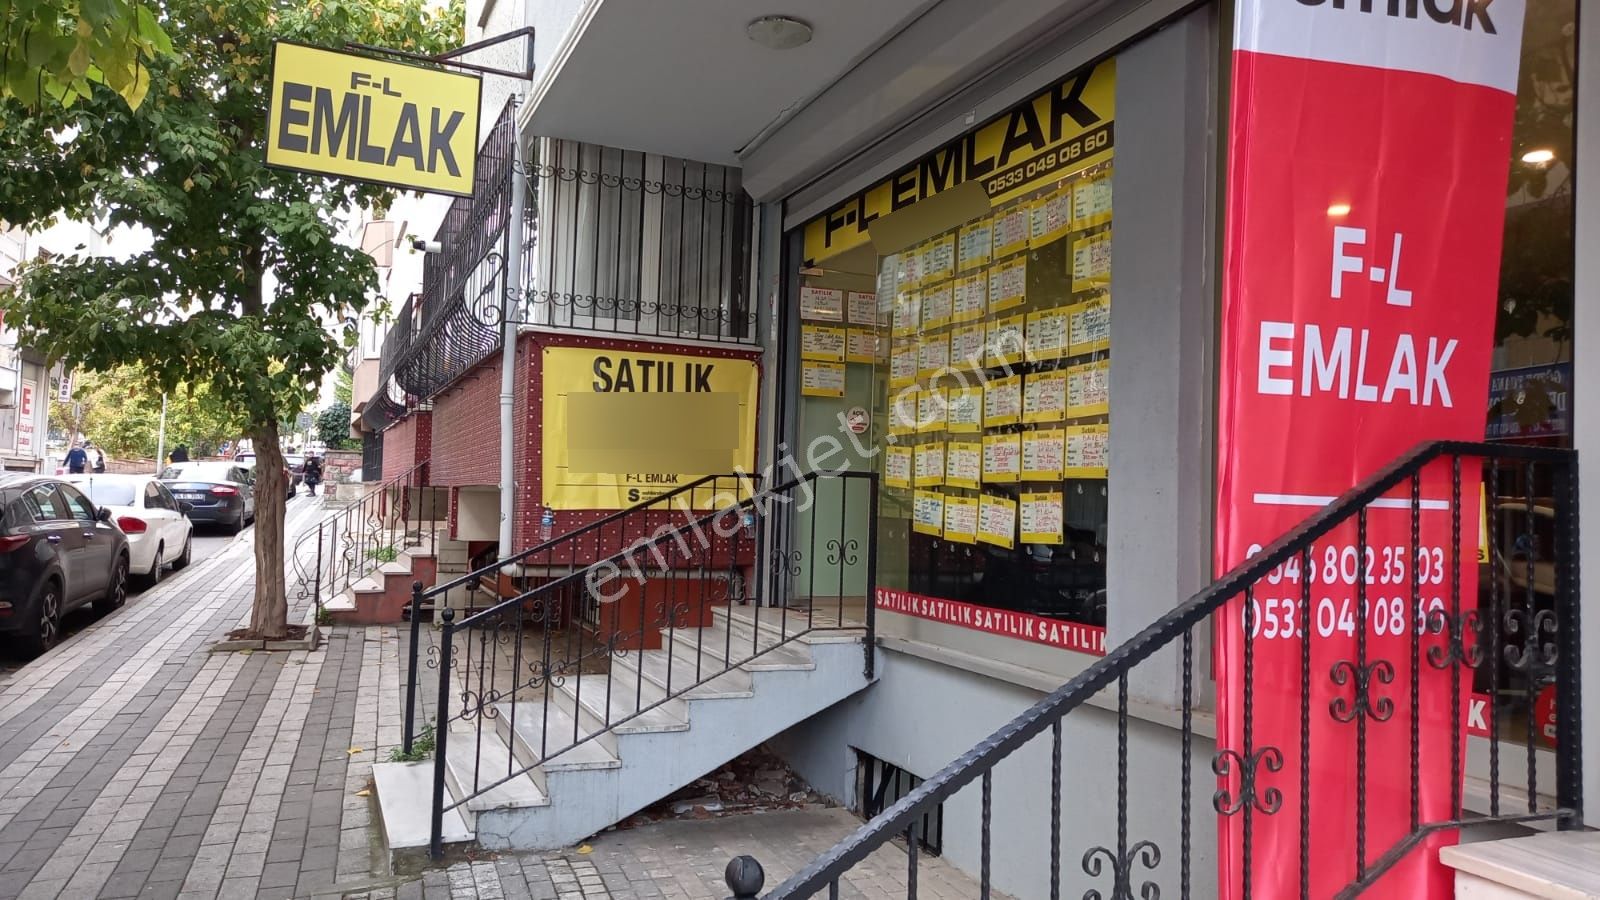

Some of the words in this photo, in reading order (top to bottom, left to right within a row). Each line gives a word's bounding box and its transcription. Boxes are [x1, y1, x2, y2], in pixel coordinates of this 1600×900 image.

[351, 71, 402, 98] F-L
[278, 81, 466, 178] EMLAK
[892, 64, 1102, 212] EMLAK
[988, 170, 1024, 195] 0533
[1026, 154, 1057, 178] 049
[1060, 142, 1082, 163] 08
[1085, 130, 1108, 150] 60
[1330, 226, 1413, 307] F-L
[1257, 320, 1460, 409] EMLAK
[626, 473, 643, 483] F-L
[645, 473, 679, 483] EMLAK
[1380, 545, 1405, 585] 35
[876, 590, 919, 613] SATILIK
[921, 602, 972, 625] SATILIK
[975, 609, 1034, 638] SATILIK
[1374, 597, 1405, 636] 08
